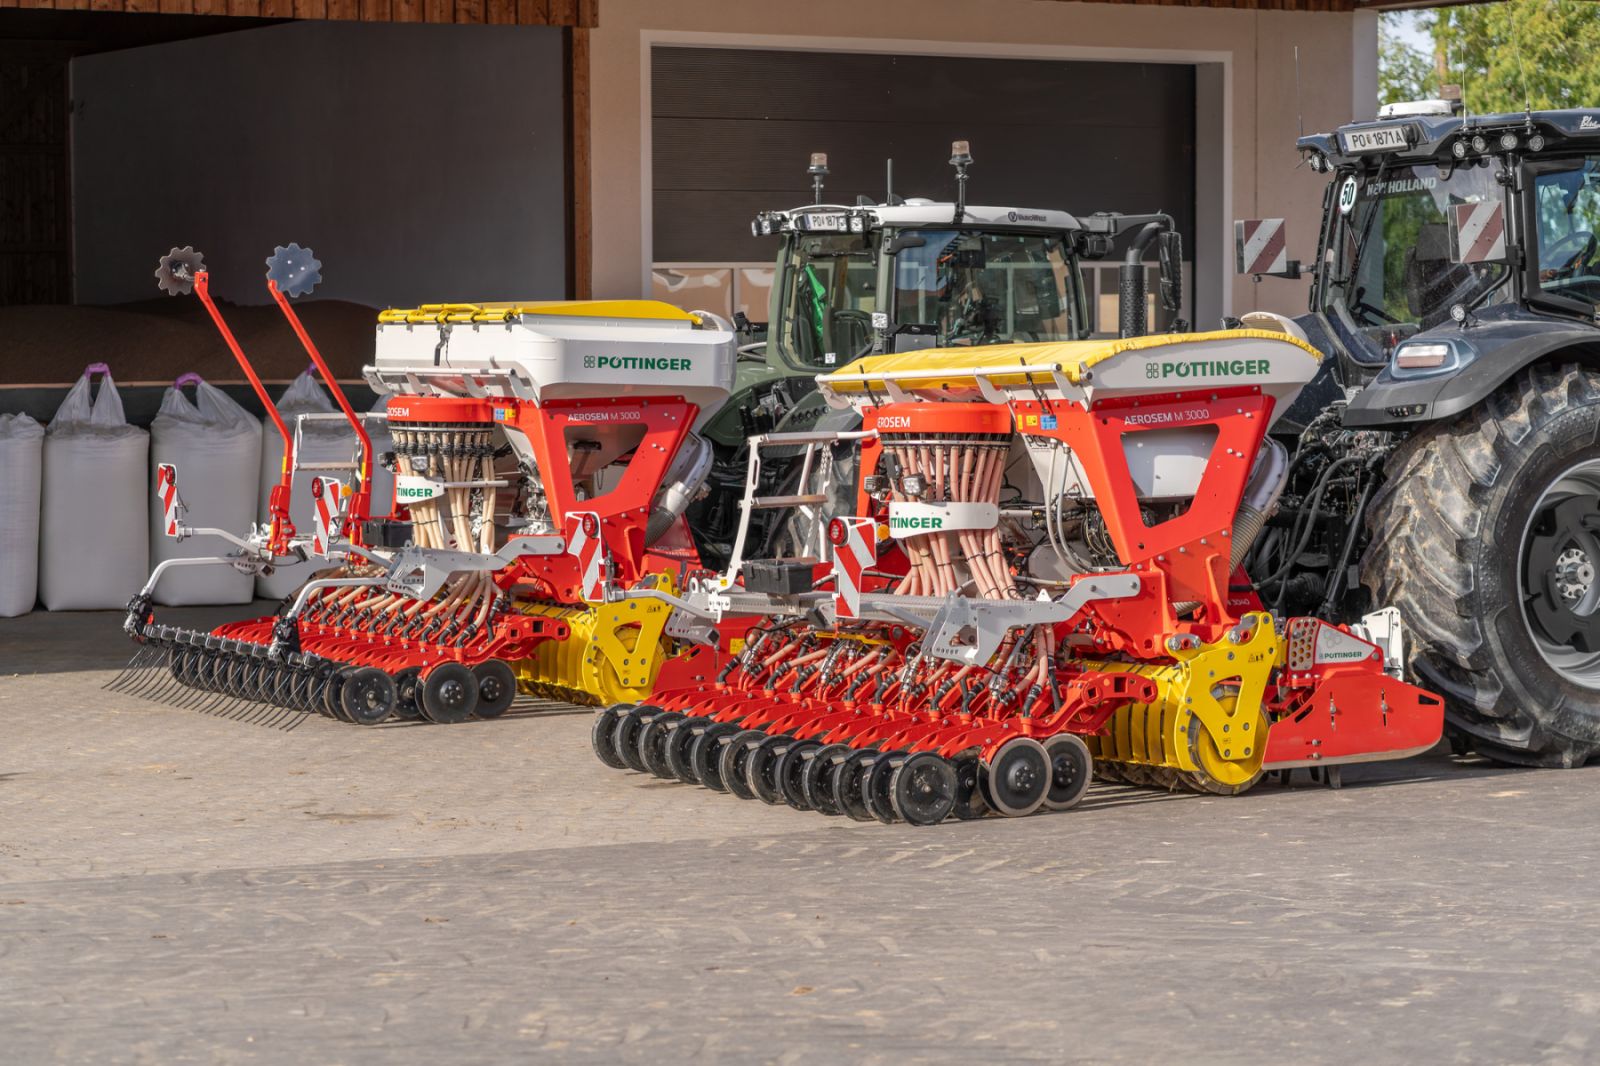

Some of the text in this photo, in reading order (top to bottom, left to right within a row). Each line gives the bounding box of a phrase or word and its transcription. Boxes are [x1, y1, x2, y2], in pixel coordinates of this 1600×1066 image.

[1351, 134, 1367, 148] PO
[1341, 182, 1355, 206] 50
[1388, 177, 1437, 194] HOLLAND
[567, 411, 640, 421] AEROSEM M 3000
[1124, 408, 1210, 426] AEROSEM M 3000
